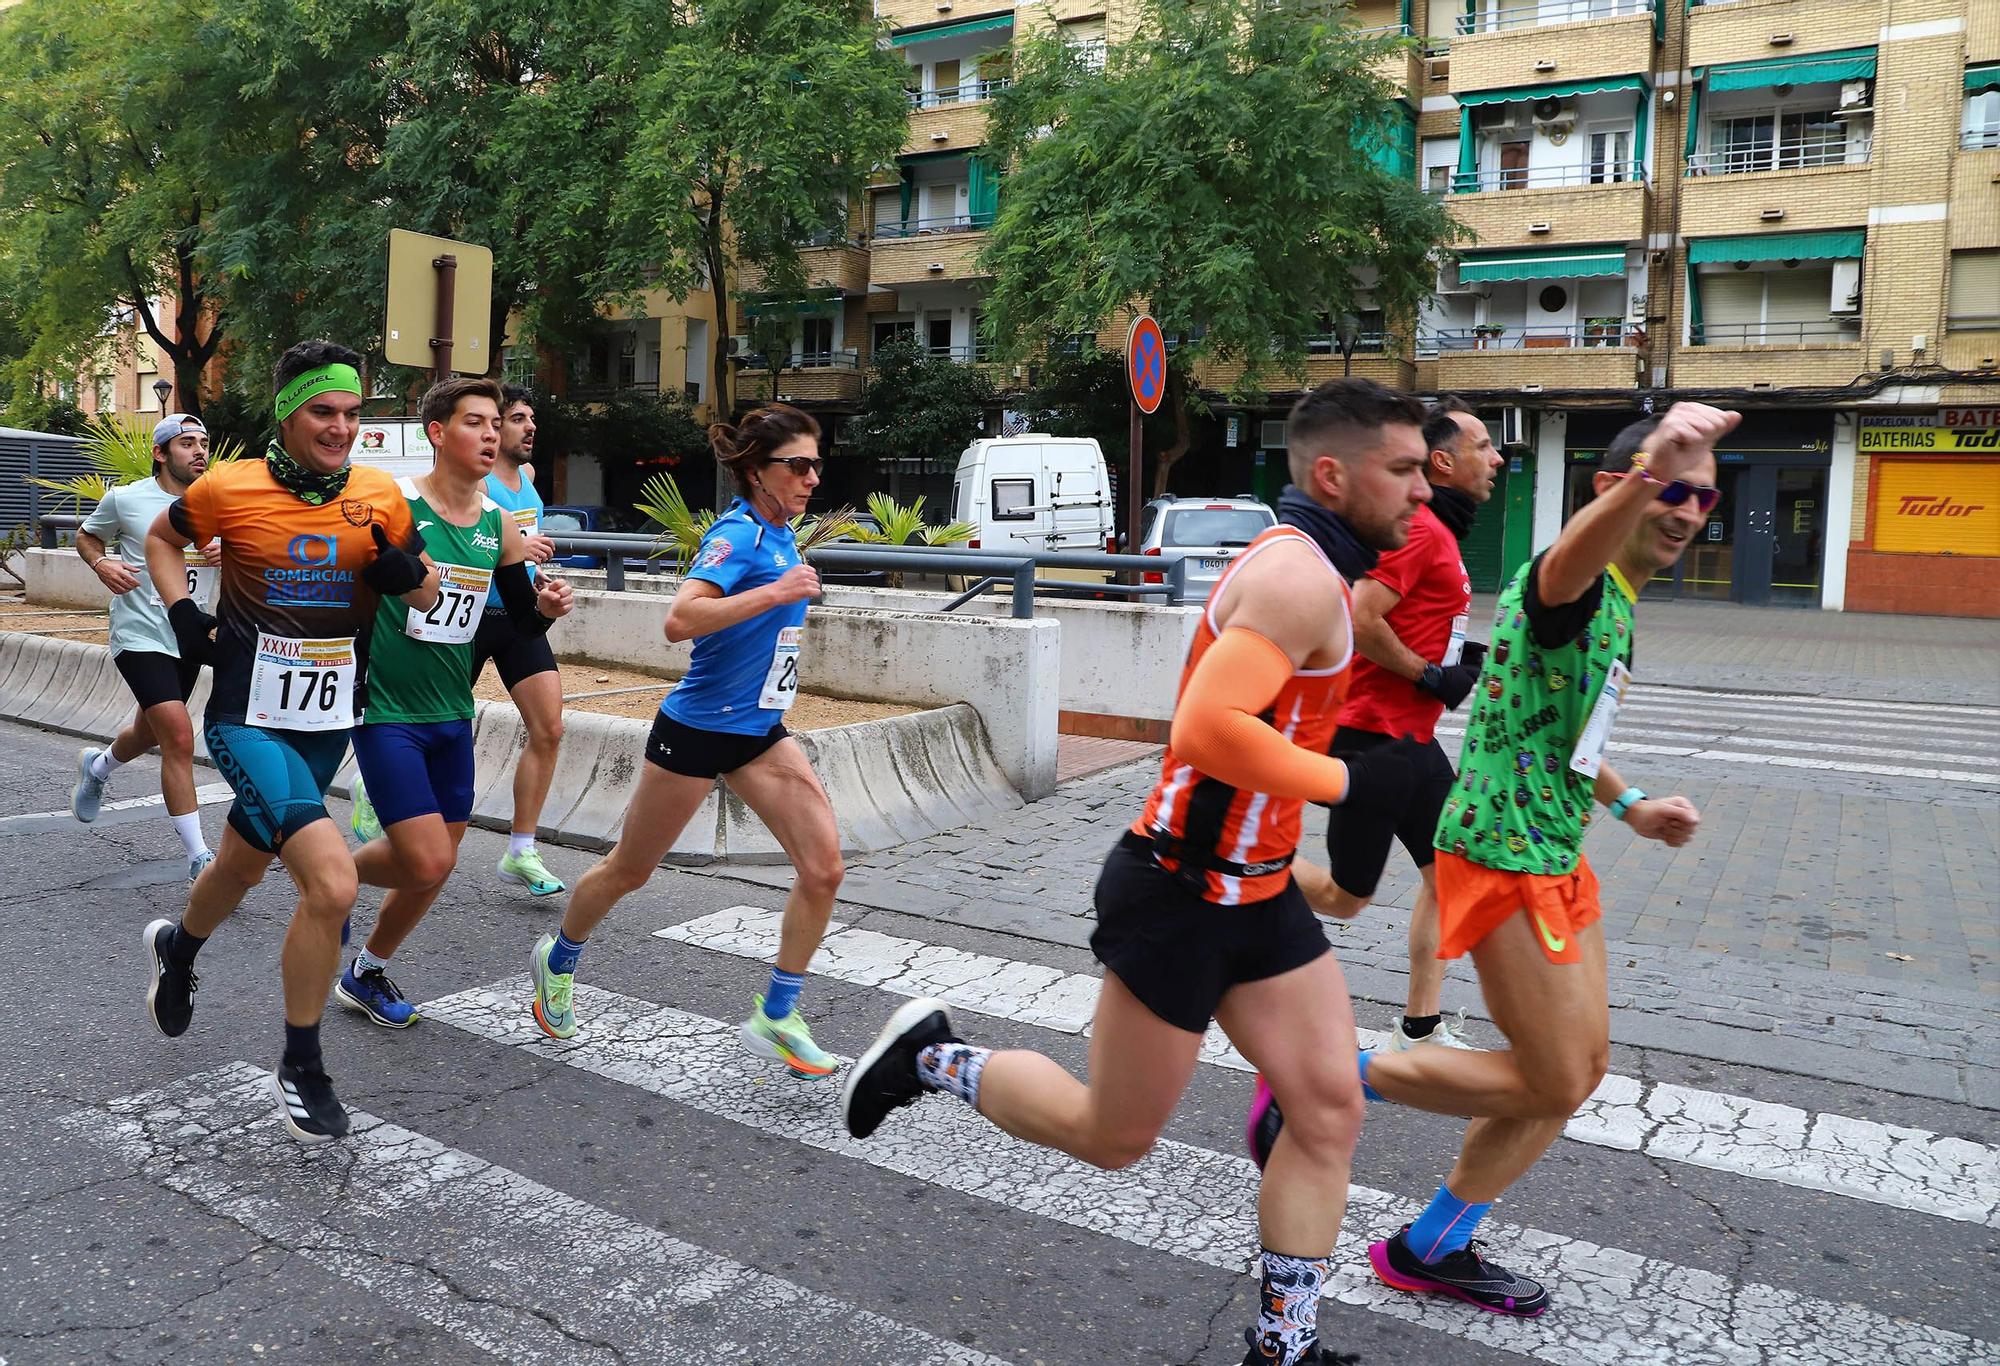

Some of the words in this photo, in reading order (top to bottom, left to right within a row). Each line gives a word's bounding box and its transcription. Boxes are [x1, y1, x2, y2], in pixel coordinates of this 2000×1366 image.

[288, 374, 335, 402] LURBEL
[1863, 417, 1915, 428] BARCELONA
[1862, 431, 1935, 448] BATERIAS
[1897, 496, 1985, 517] Tudor
[1204, 560, 1224, 568] 0401
[264, 568, 354, 583] COMERCIAL
[425, 591, 475, 628] 273
[262, 637, 302, 657] XXXIX
[279, 671, 338, 711] 176
